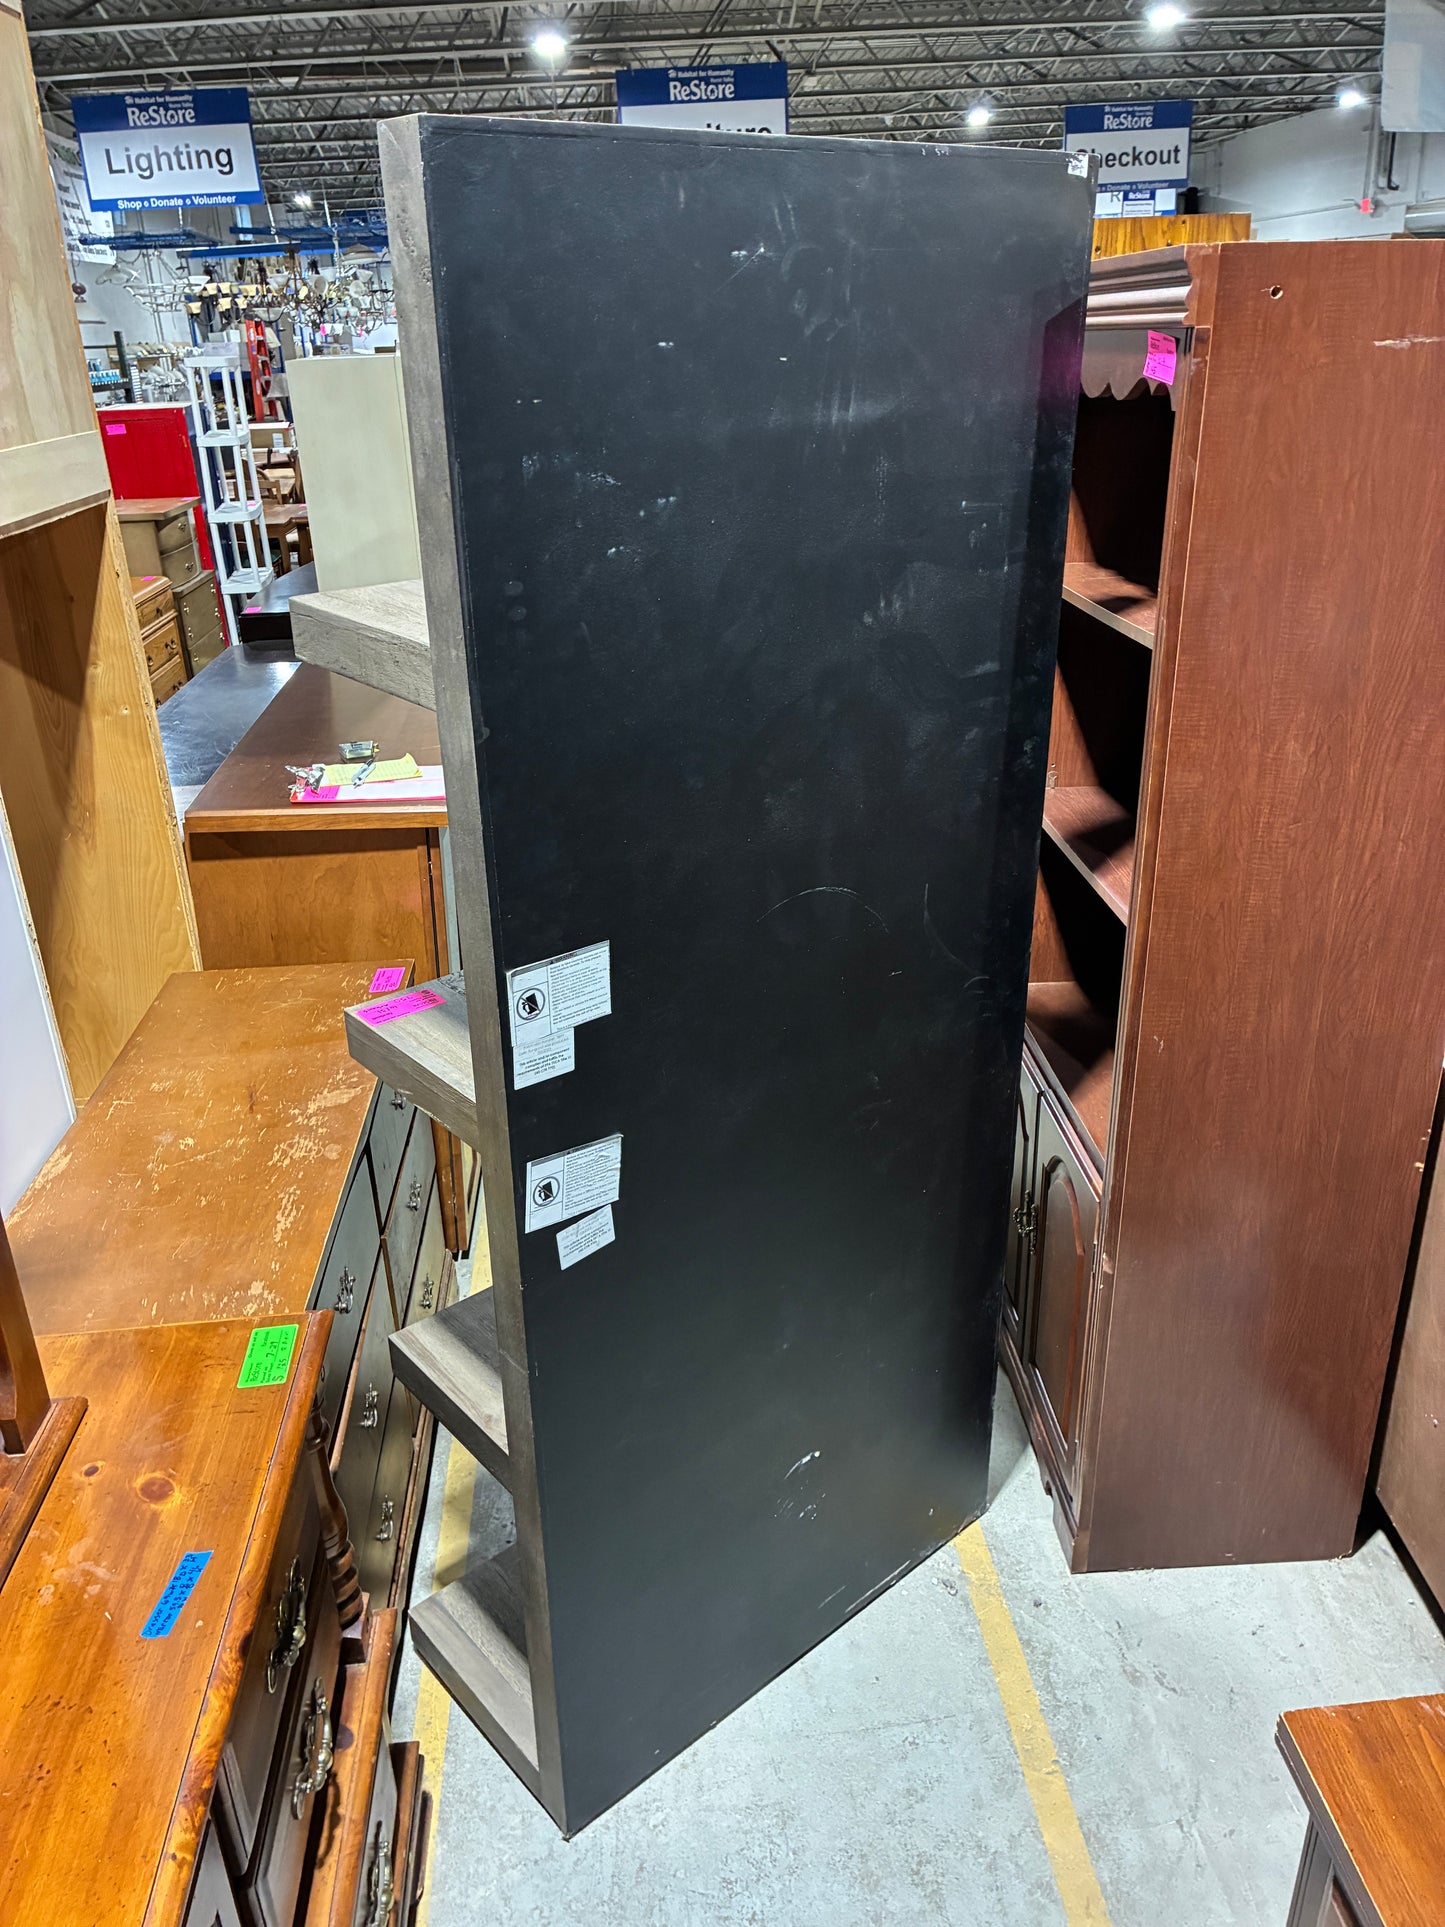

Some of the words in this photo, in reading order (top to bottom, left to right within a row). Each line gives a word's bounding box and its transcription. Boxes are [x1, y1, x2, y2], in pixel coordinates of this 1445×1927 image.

[678, 70, 698, 78] Habitat
[708, 69, 734, 77] Humanity
[134, 96, 156, 104] Habitat
[165, 94, 193, 102] Humanity
[669, 80, 734, 101] ReStore
[127, 106, 196, 127] ReStore
[1104, 114, 1153, 130] ReStore
[105, 143, 234, 180] Lighting
[1076, 144, 1180, 168] eckout
[118, 199, 142, 210] Shop
[151, 196, 184, 207] Donate
[192, 194, 236, 205] Volunteer
